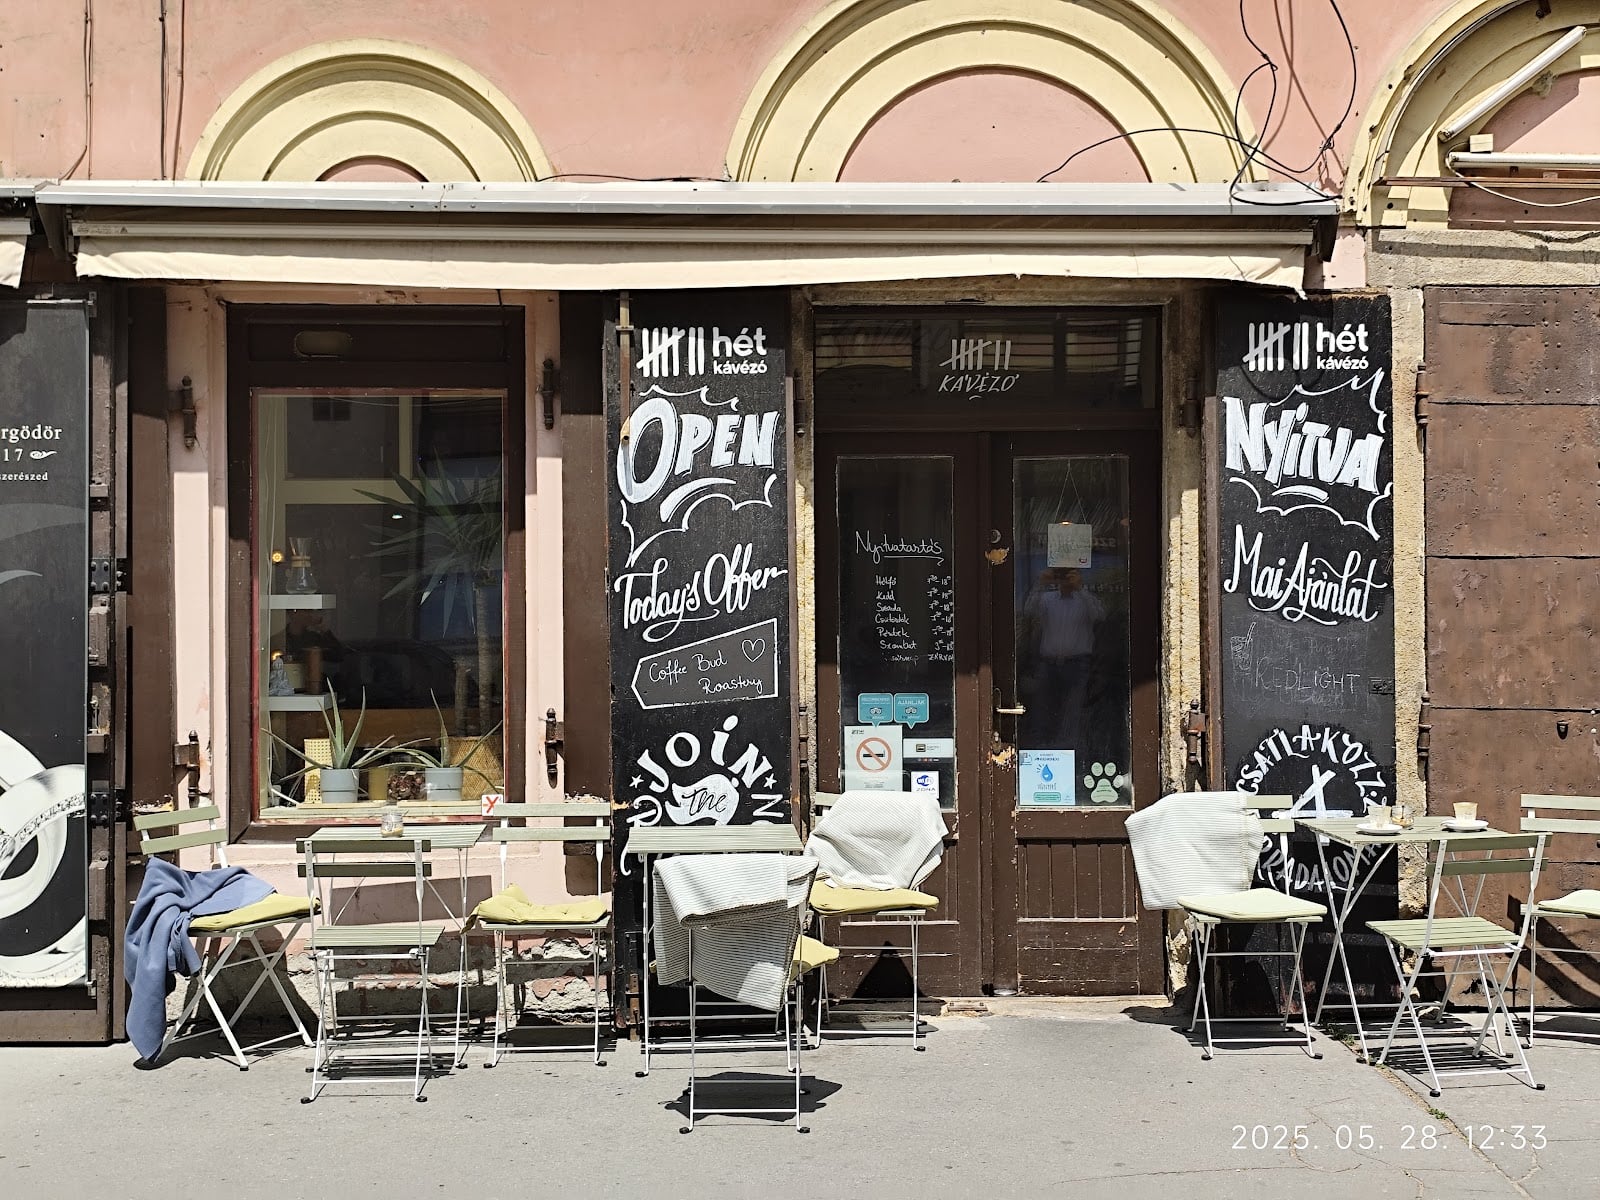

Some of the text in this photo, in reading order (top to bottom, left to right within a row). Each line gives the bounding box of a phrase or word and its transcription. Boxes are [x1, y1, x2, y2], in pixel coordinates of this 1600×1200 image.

[712, 326, 767, 357] hét
[1316, 322, 1369, 353] hét
[713, 359, 768, 375] kávézó
[1316, 355, 1369, 370] kávézó
[0, 423, 63, 444] rgödör
[617, 398, 780, 504] OPEN
[0, 471, 49, 481] zerészed
[855, 529, 943, 564] Nyitvatartás
[1224, 524, 1388, 626] Mai Ajánlat
[613, 543, 789, 642] Today's Offer
[648, 649, 728, 687] Coffee Bud
[698, 675, 763, 695] Roastery
